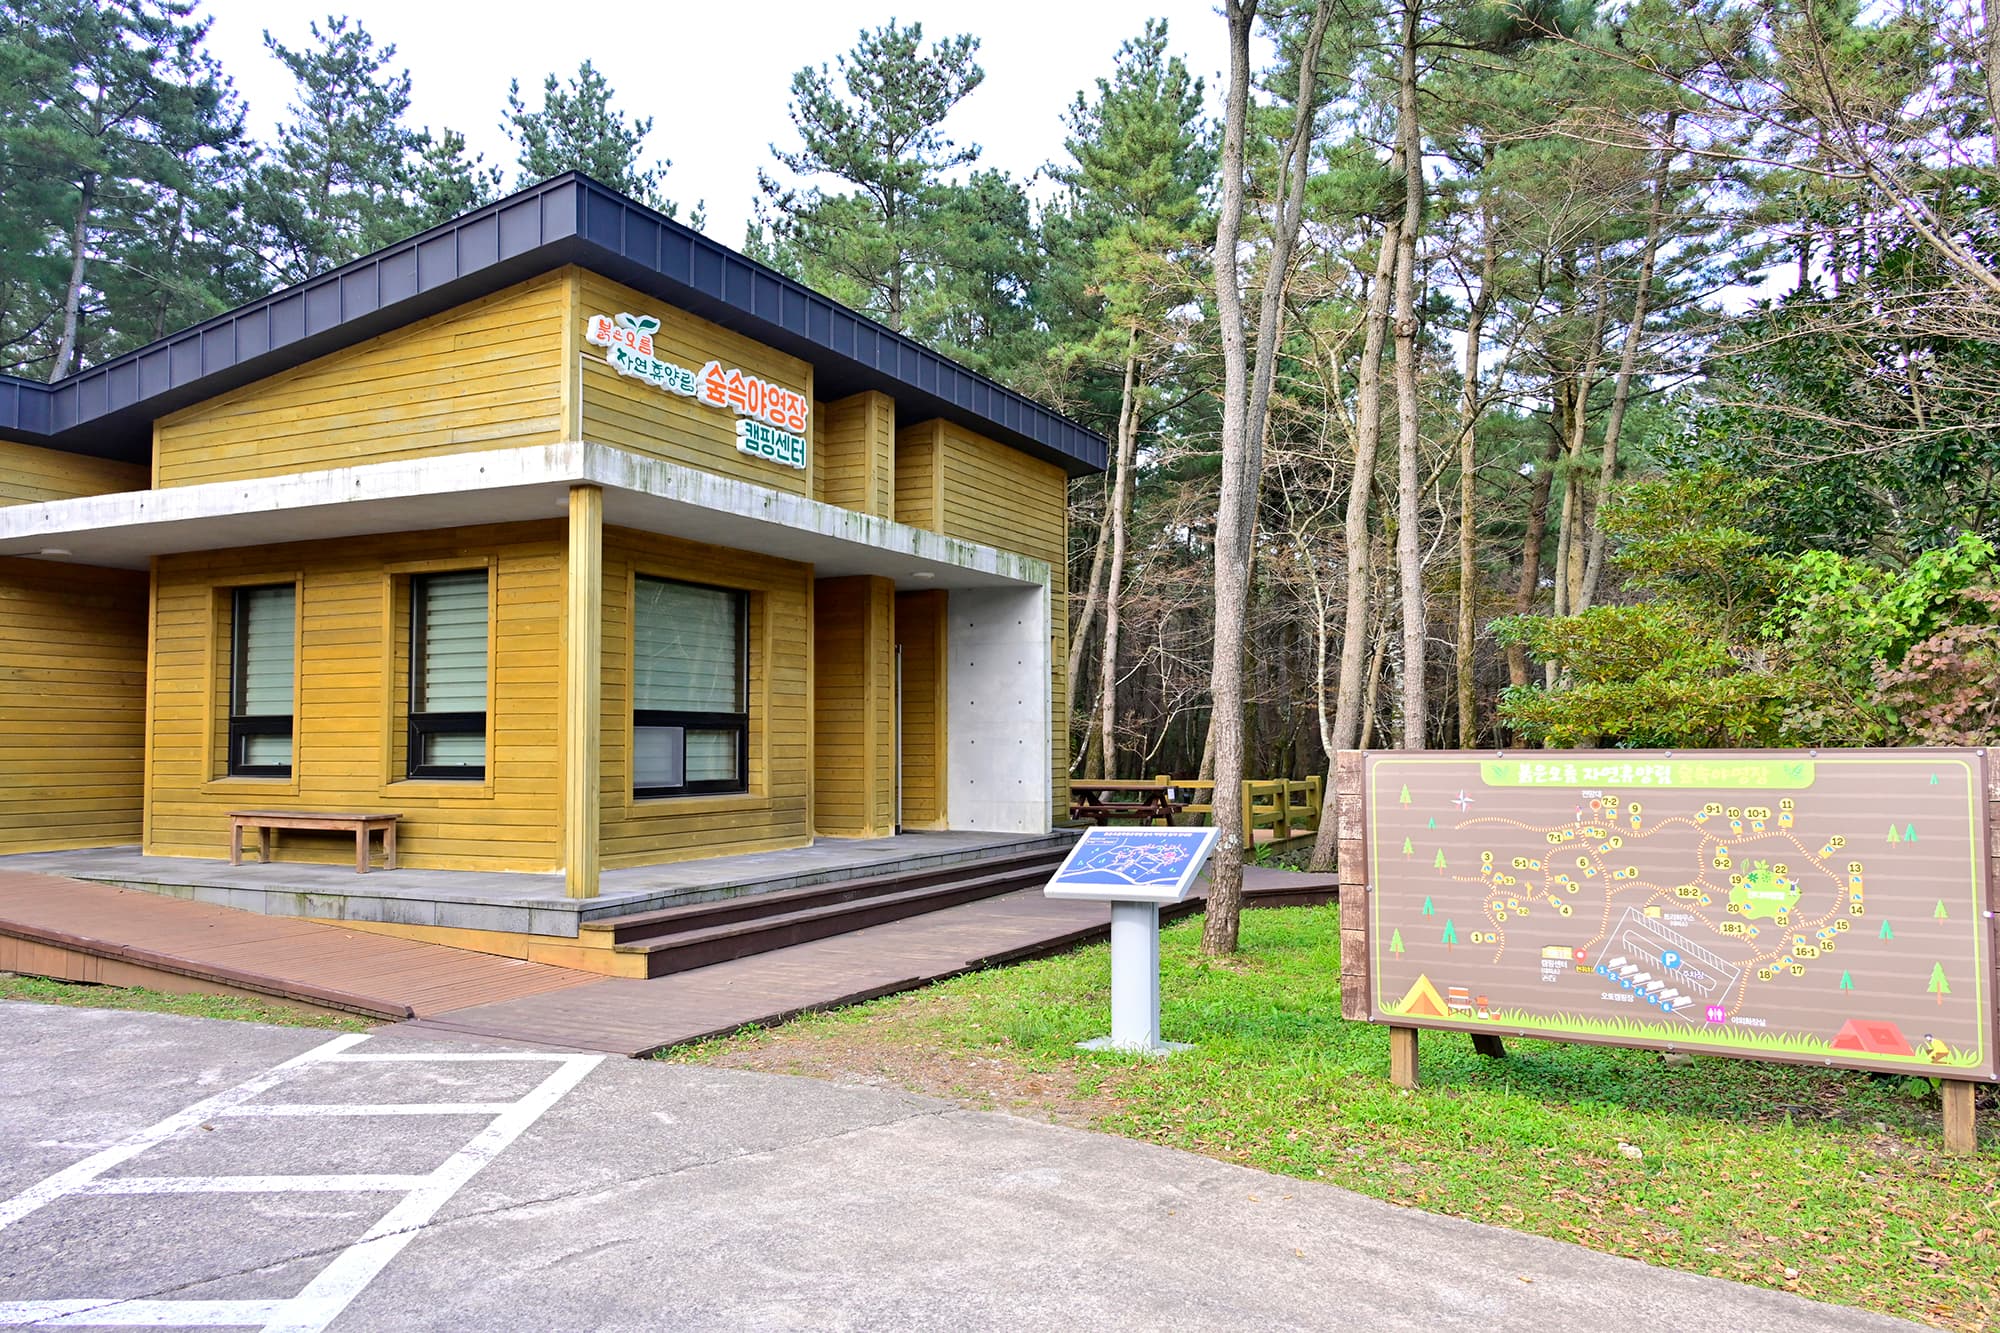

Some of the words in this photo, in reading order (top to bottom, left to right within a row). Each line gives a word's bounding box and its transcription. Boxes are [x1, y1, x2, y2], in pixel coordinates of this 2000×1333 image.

[597, 319, 652, 355] 붉은오름
[617, 348, 695, 392] 자연휴양림
[705, 364, 807, 431] 숲속야영장
[745, 421, 805, 466] 캠핑센터
[1583, 764, 1673, 785] 자연휴양림
[1683, 970, 1704, 980] 주차장
